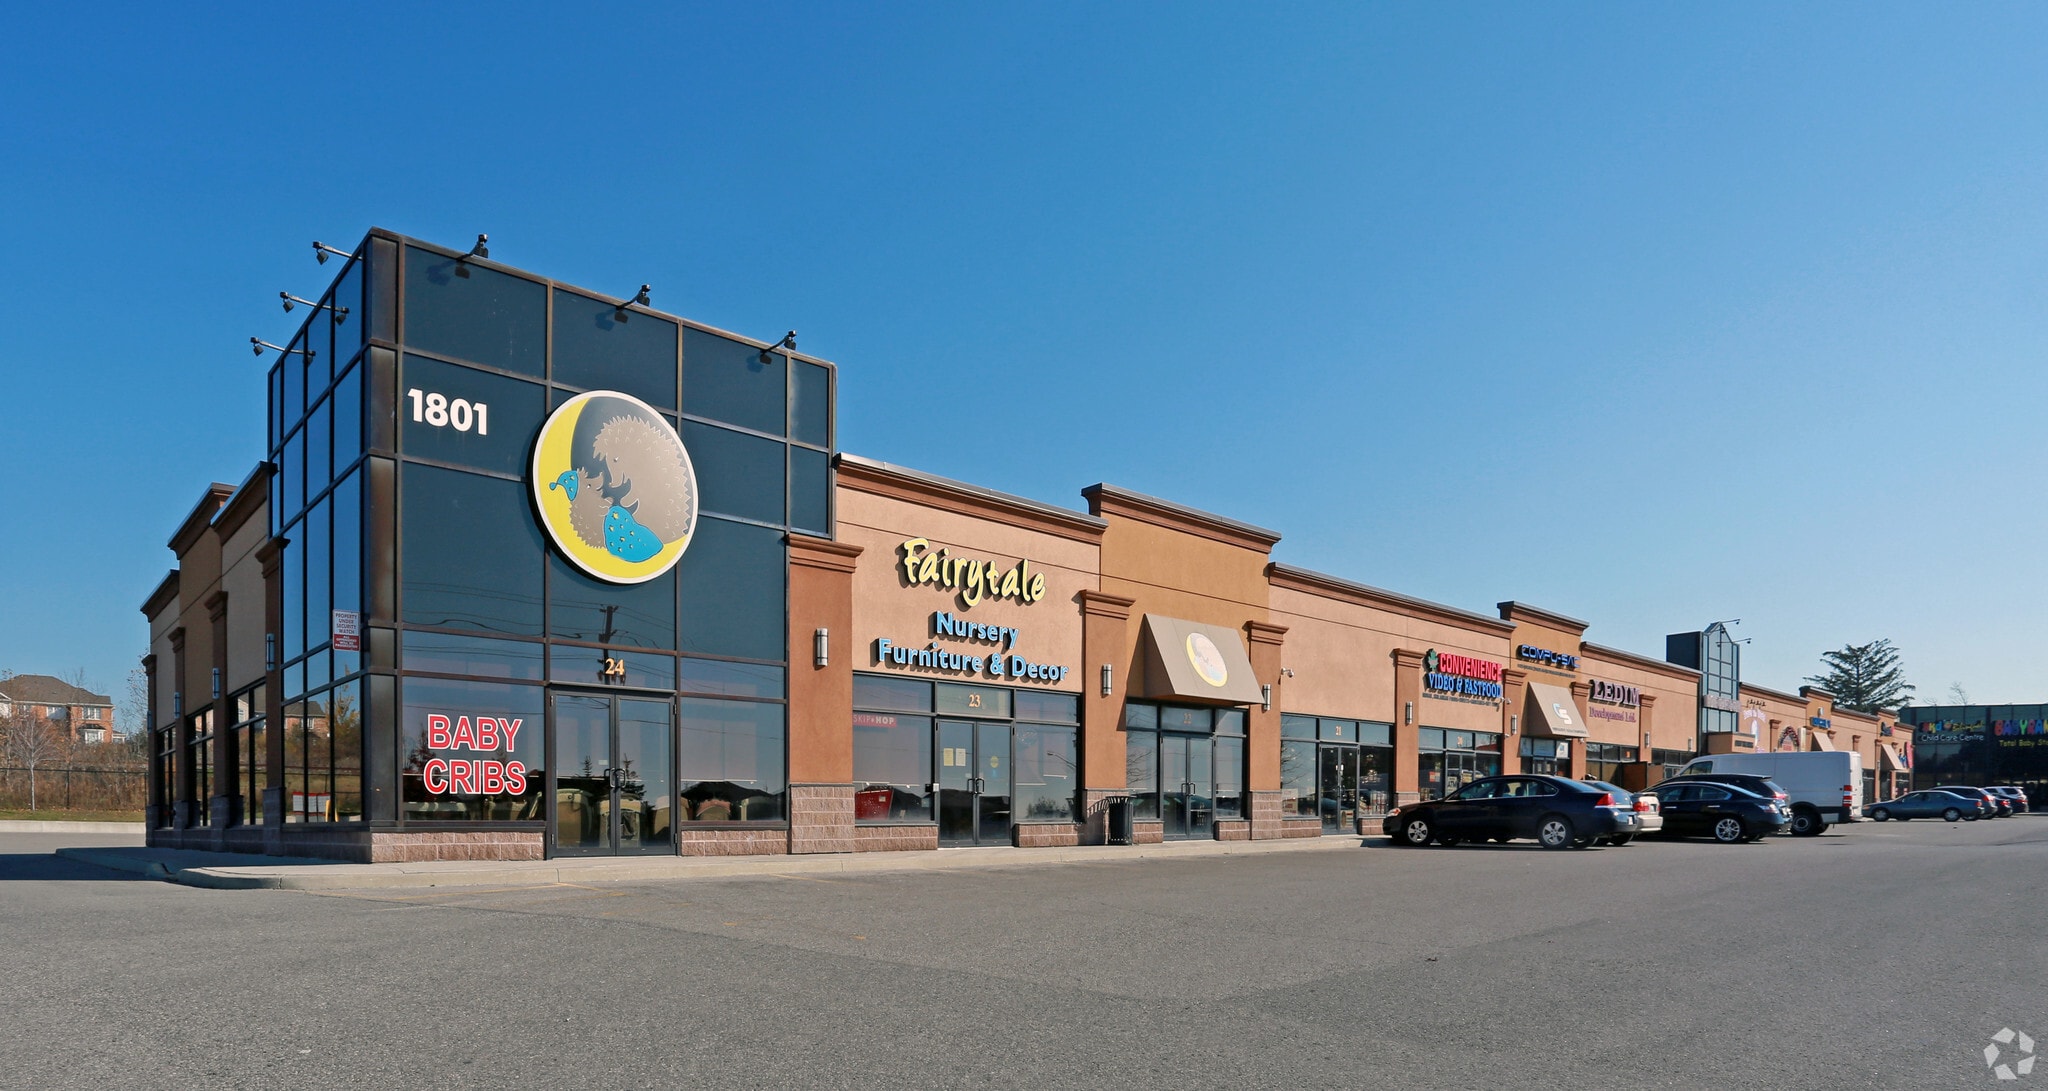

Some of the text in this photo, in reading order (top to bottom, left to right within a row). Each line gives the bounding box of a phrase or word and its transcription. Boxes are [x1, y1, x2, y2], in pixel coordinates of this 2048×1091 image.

[408, 388, 487, 435] 1801
[904, 537, 1046, 607] Fairytale
[936, 611, 1019, 650] Nursery
[605, 658, 625, 675] 24
[878, 637, 1069, 681] Furniture & Decor
[1439, 653, 1502, 681] CONVENIENCE
[1428, 673, 1503, 698] VIDEO & FASTFOOD
[1593, 680, 1640, 706] LEDIM
[969, 694, 981, 707] 23
[427, 713, 523, 752] BABY
[853, 714, 894, 725] SKIP HOP
[1922, 734, 1939, 742] Child
[1941, 734, 1958, 742] Care
[423, 759, 527, 795] CRIBS
